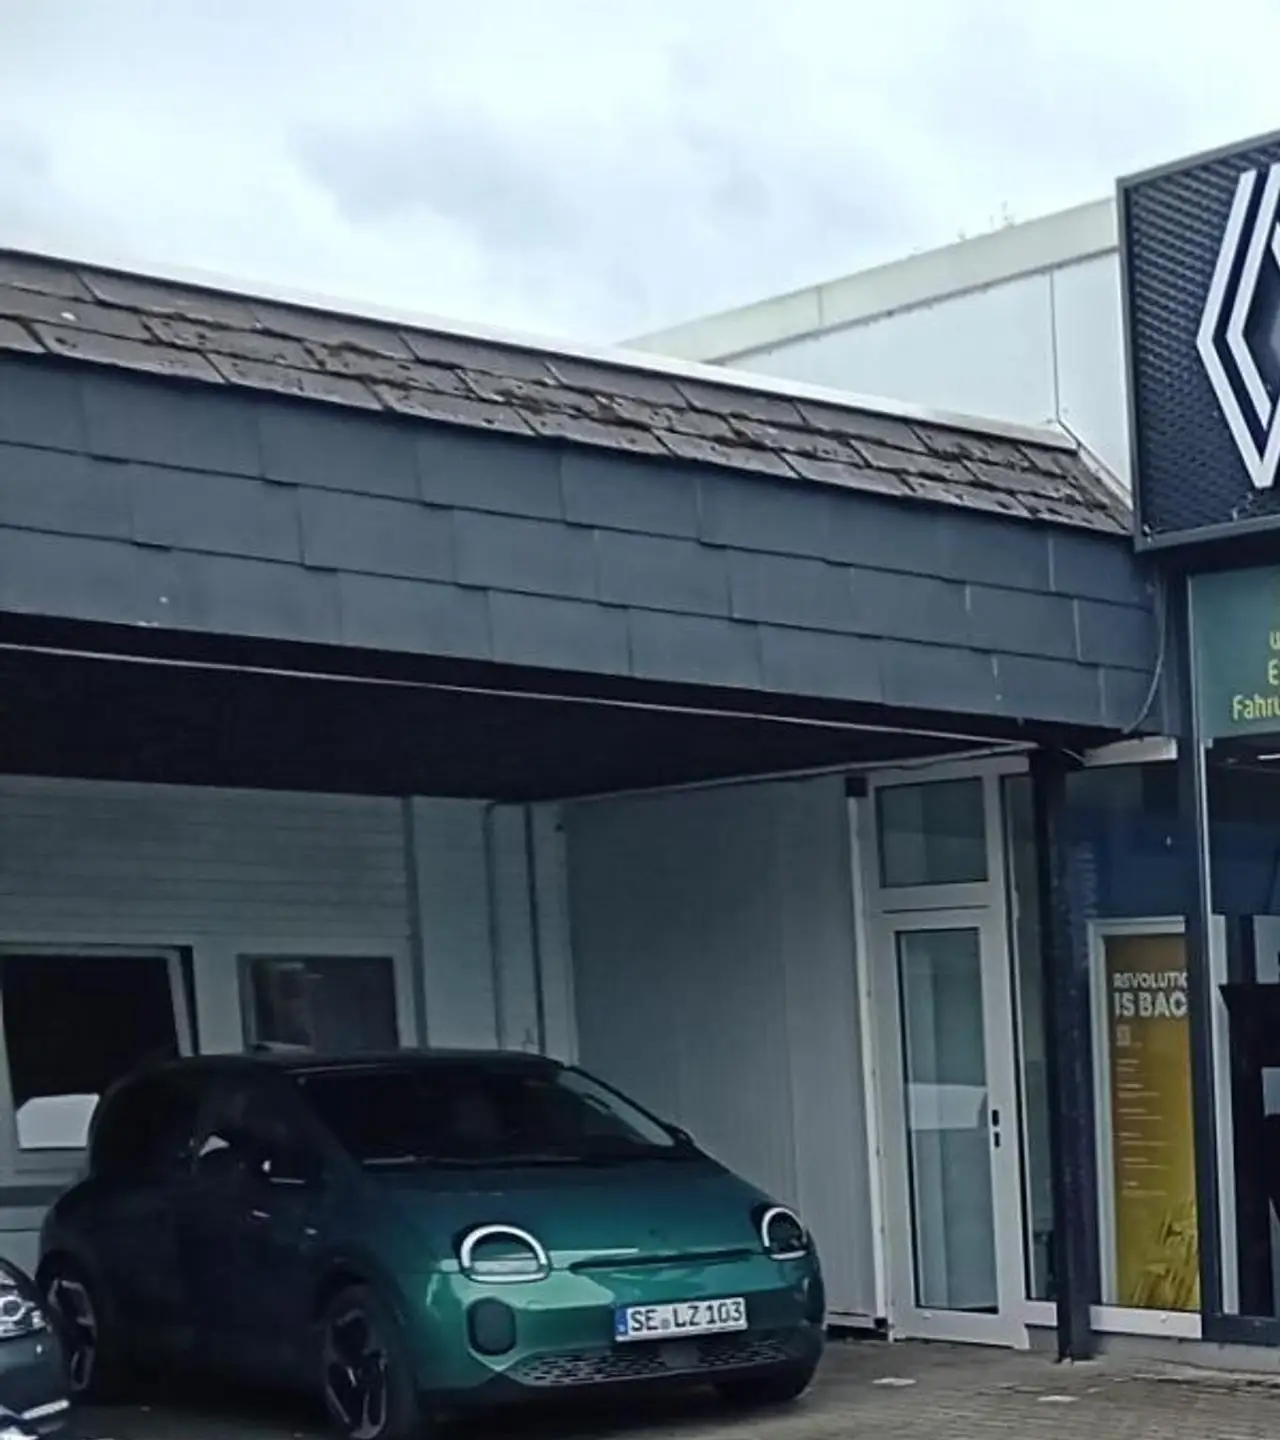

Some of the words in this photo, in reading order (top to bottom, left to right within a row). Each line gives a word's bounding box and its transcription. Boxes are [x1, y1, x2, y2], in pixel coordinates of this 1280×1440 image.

[1114, 992, 1136, 1018] IS
[630, 1308, 659, 1332] SE
[672, 1304, 701, 1328] LZ
[705, 1301, 742, 1324] 103
